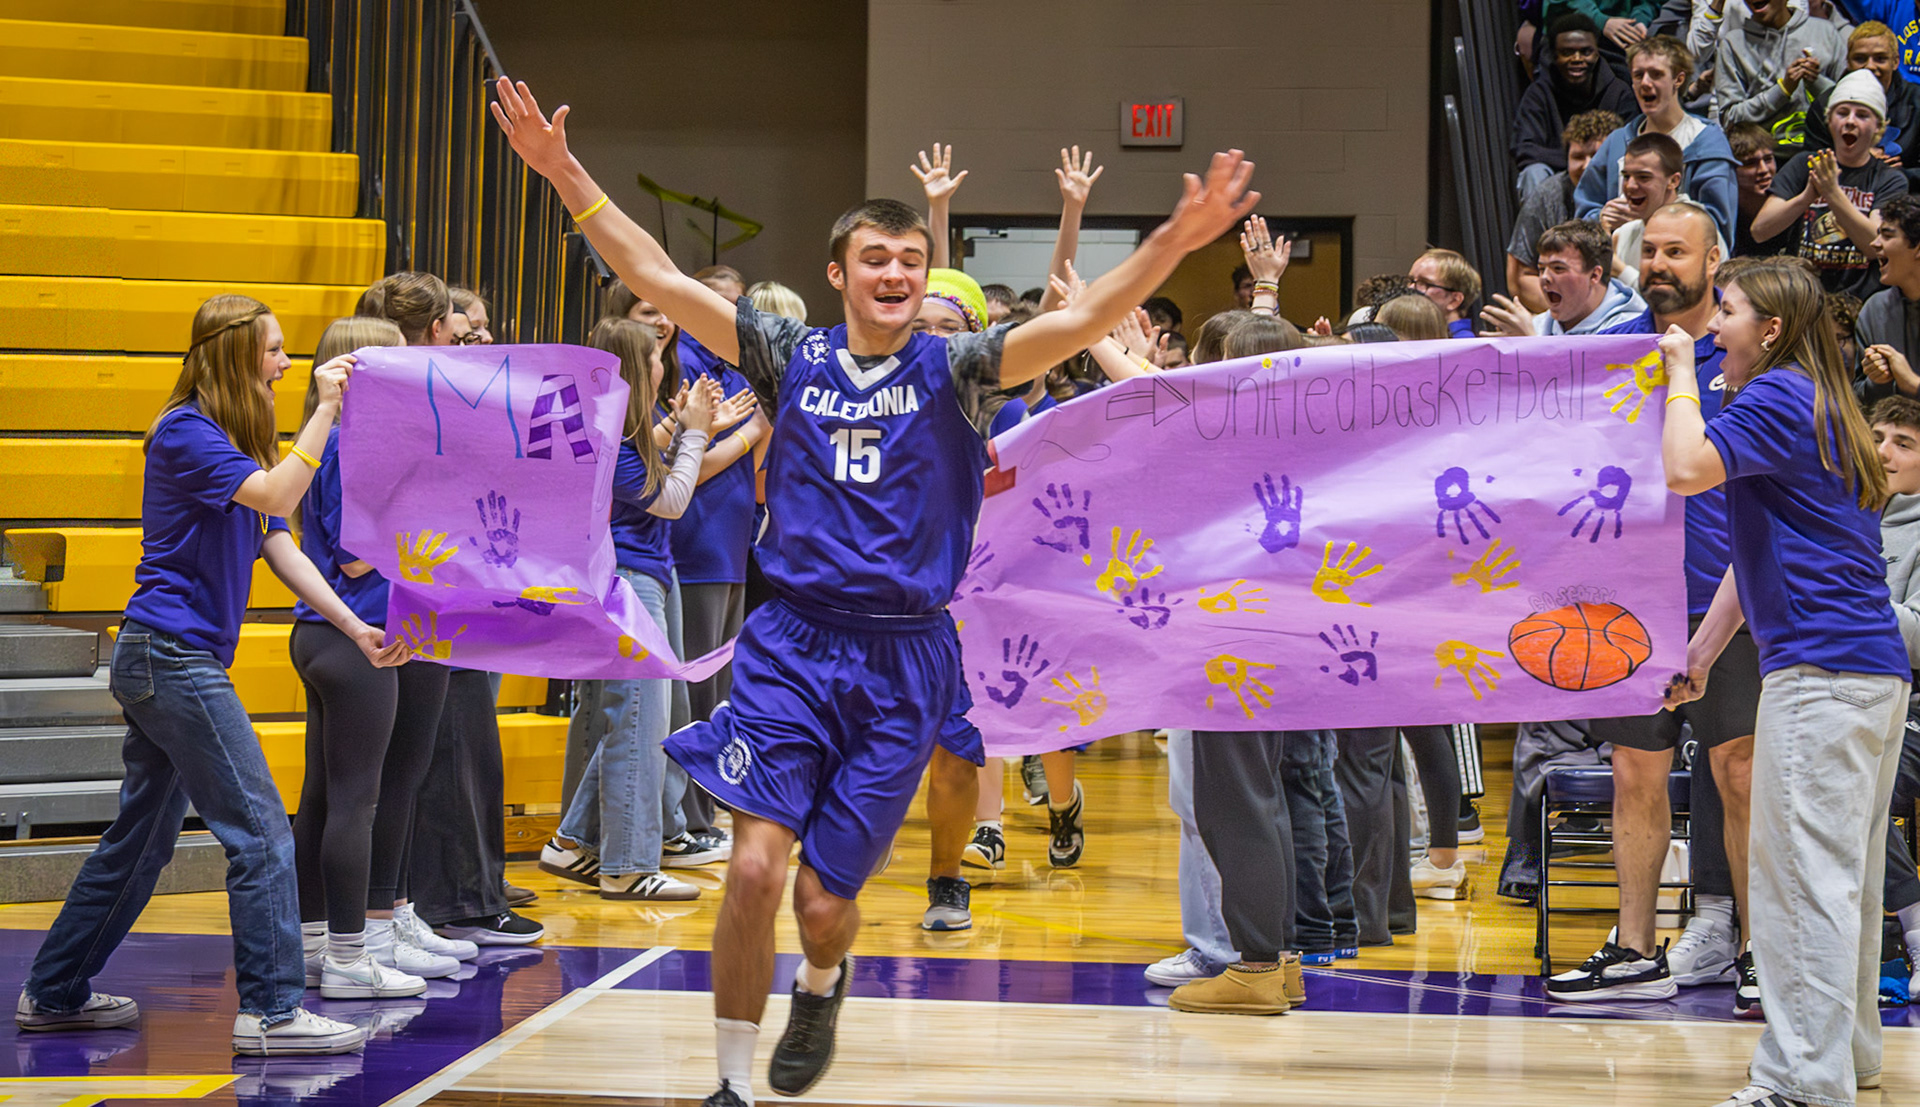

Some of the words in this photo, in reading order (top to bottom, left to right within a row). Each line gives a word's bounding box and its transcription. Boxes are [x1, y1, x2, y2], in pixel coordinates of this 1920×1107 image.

[1132, 104, 1176, 138] EXIT
[800, 384, 920, 421] CALEDONIA
[1193, 354, 1357, 441] Unified
[1371, 348, 1585, 430] basketball
[829, 428, 882, 484] 15
